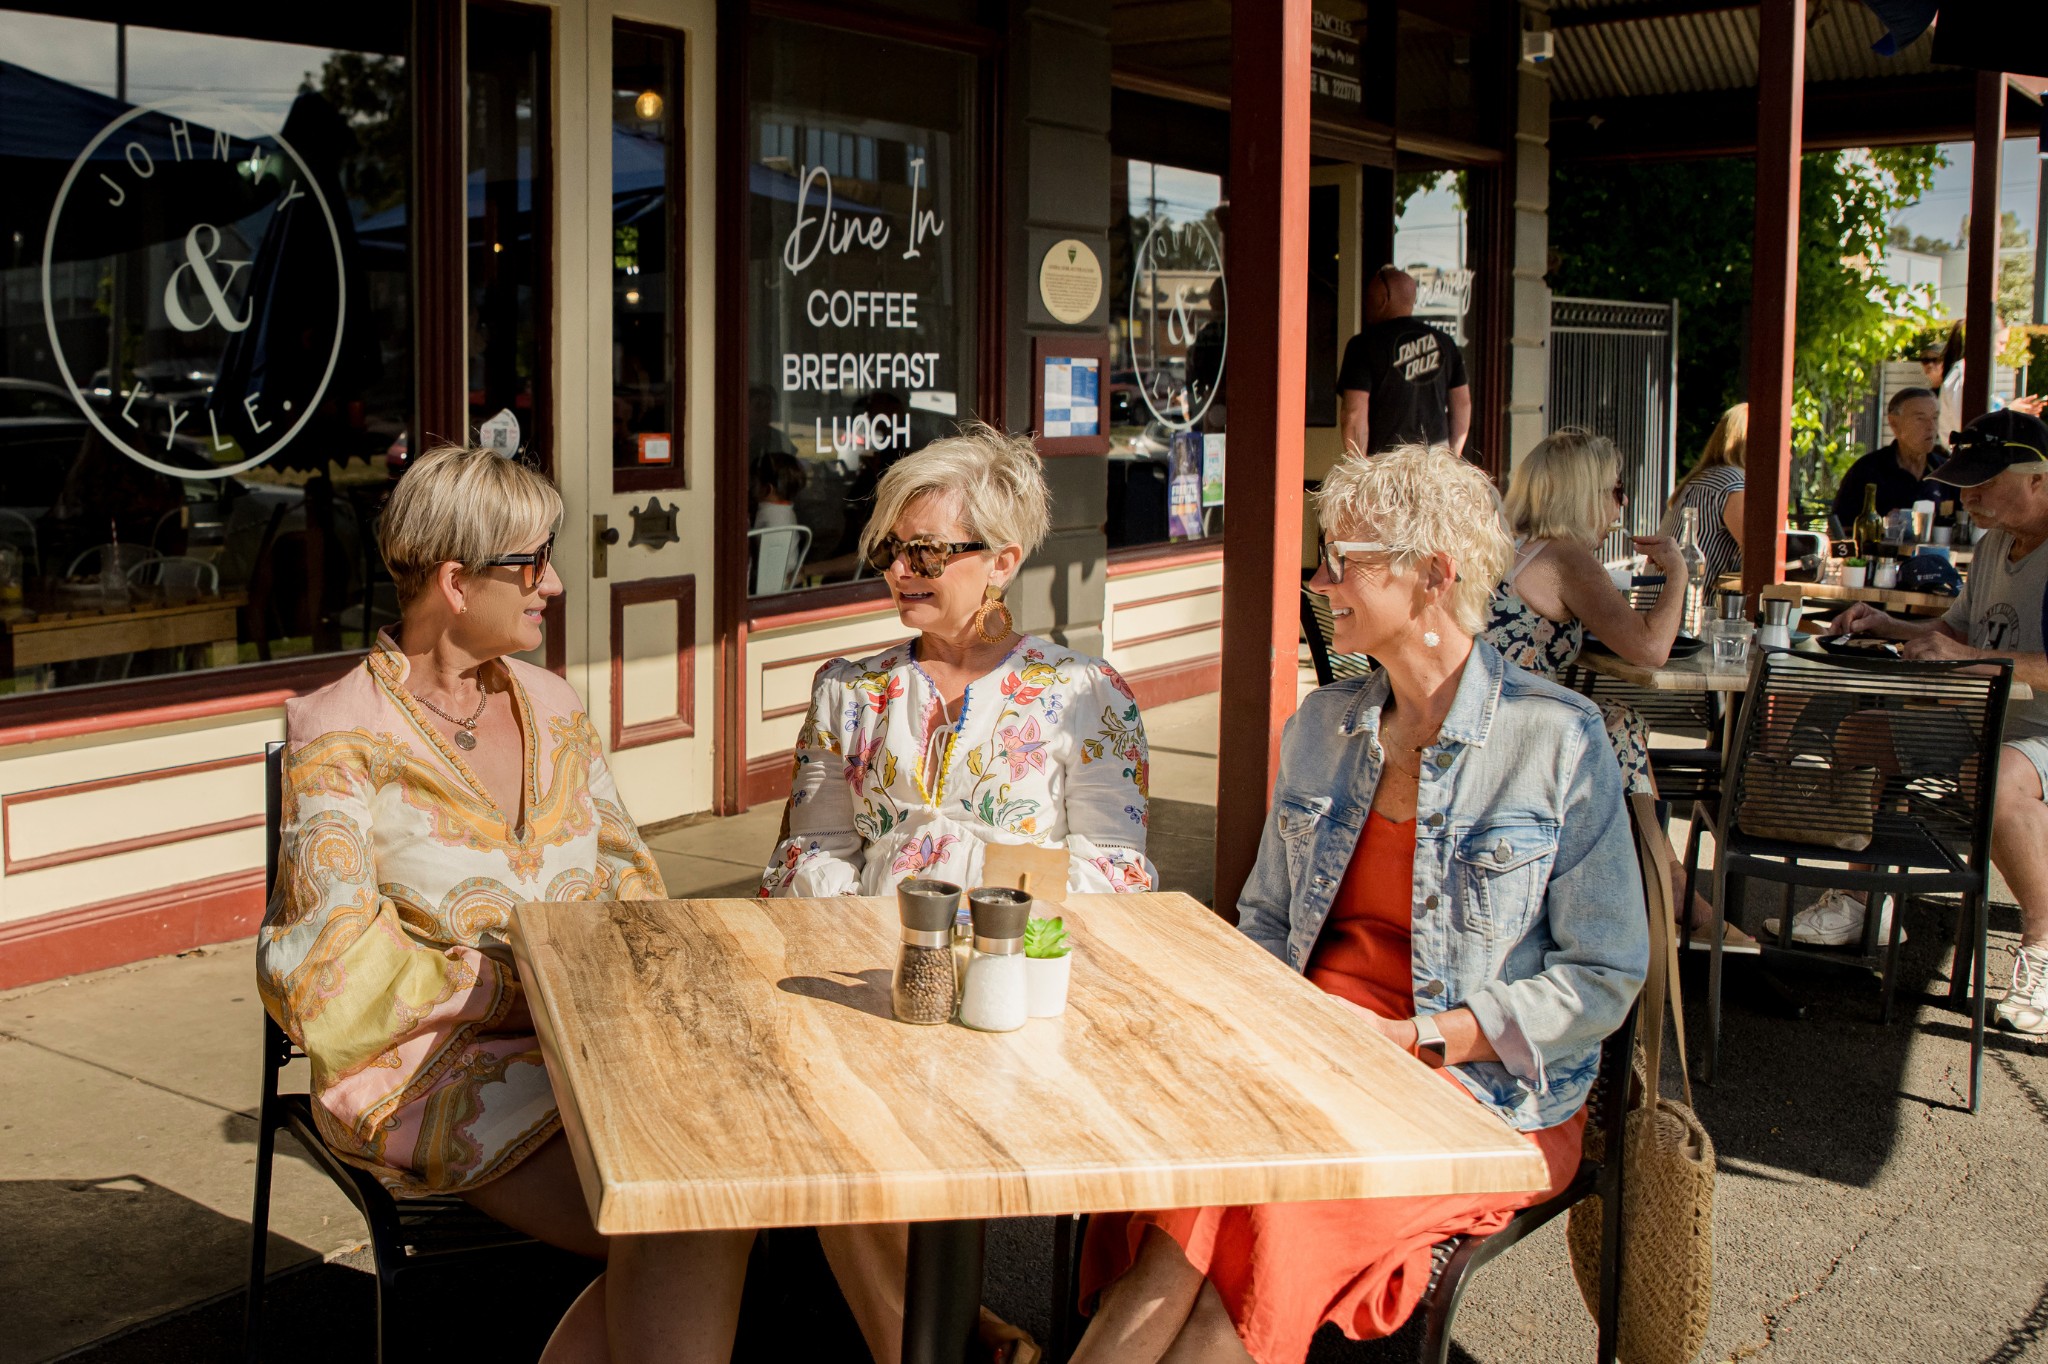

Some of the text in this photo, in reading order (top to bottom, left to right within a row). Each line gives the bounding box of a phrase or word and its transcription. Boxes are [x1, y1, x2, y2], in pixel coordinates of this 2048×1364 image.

[100, 119, 305, 212] JOHNNY
[783, 158, 944, 276] Dine In
[164, 223, 254, 333] &
[807, 289, 918, 328] COFFEE
[1393, 333, 1438, 368] SANTA
[1405, 350, 1440, 381] CRUZ
[782, 353, 940, 391] BREAKFAST
[1152, 372, 1209, 413] LYE.
[816, 413, 911, 453] LUNCH
[1837, 543, 1848, 556] 3
